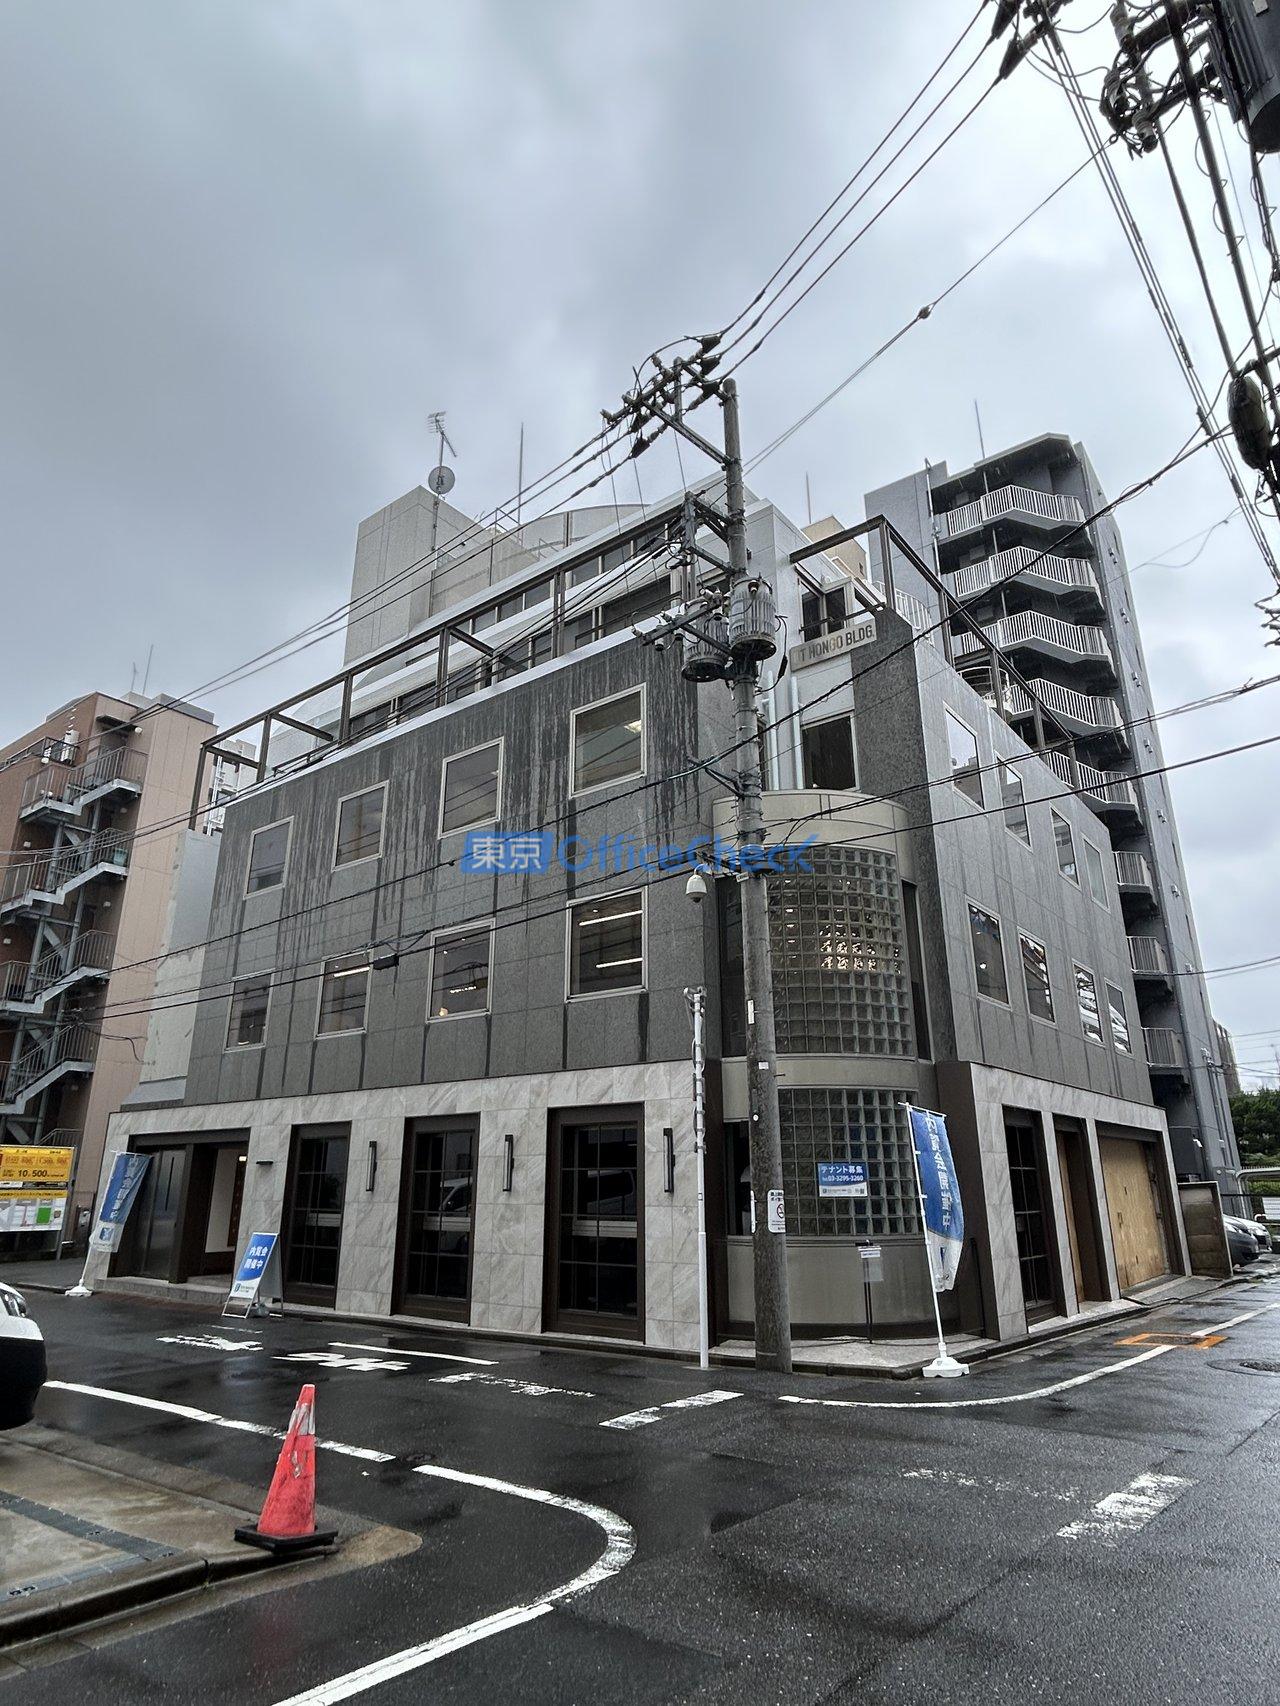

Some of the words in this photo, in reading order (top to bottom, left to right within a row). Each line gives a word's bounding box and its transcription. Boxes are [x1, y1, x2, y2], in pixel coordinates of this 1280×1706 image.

[808, 635, 844, 659] HONGO
[845, 624, 875, 646] BLDG.
[821, 1165, 863, 1174] テナント募集
[249, 1245, 268, 1257] 内覧会
